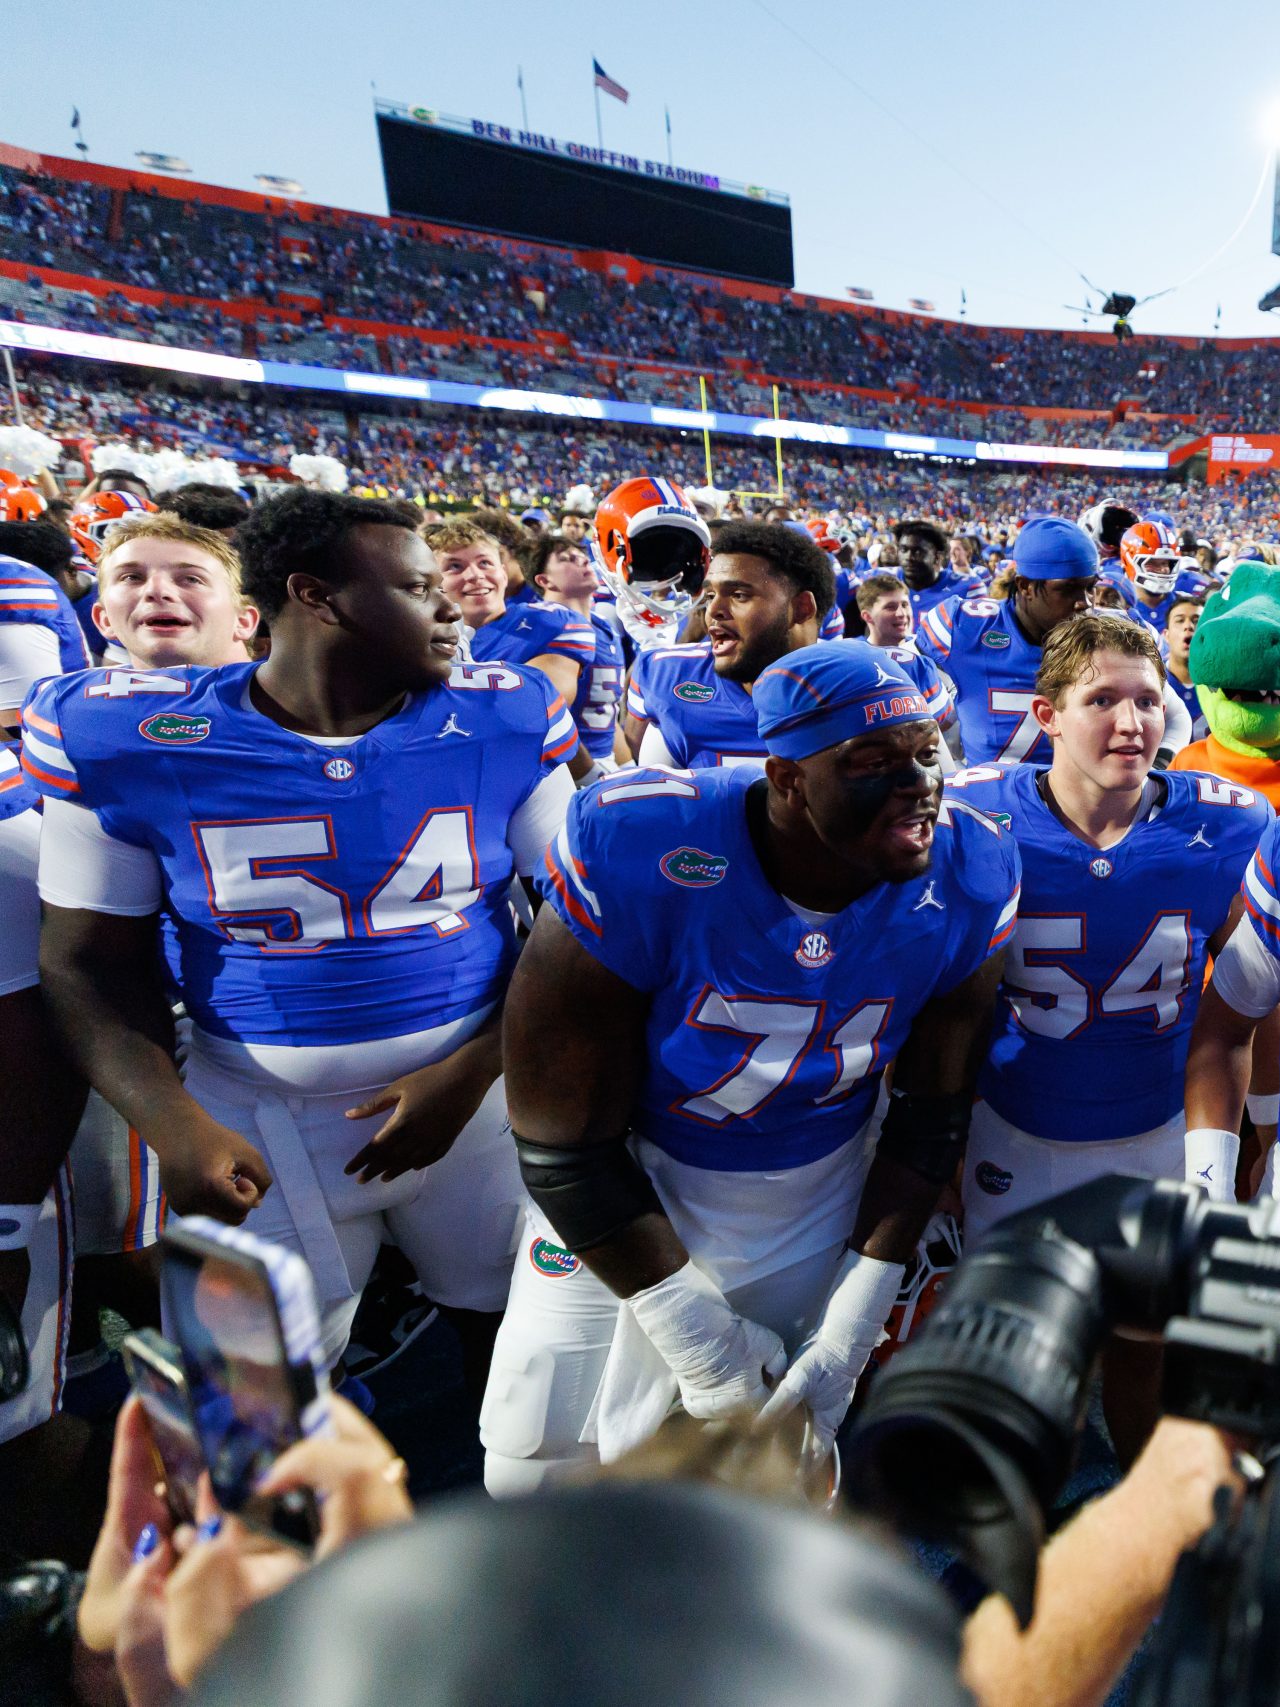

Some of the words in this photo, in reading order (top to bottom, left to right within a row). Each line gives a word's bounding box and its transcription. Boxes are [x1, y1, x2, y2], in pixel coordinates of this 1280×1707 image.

[472, 119, 511, 142] BEN
[519, 130, 558, 151] HILL
[566, 141, 639, 172] GRIFFIN
[645, 159, 720, 190] STADIUM
[325, 759, 354, 781] SEC
[191, 805, 487, 954] 54
[1091, 859, 1112, 878] SEC
[804, 933, 829, 959] SEC
[1002, 910, 1193, 1040] 54
[667, 983, 896, 1129] 71
